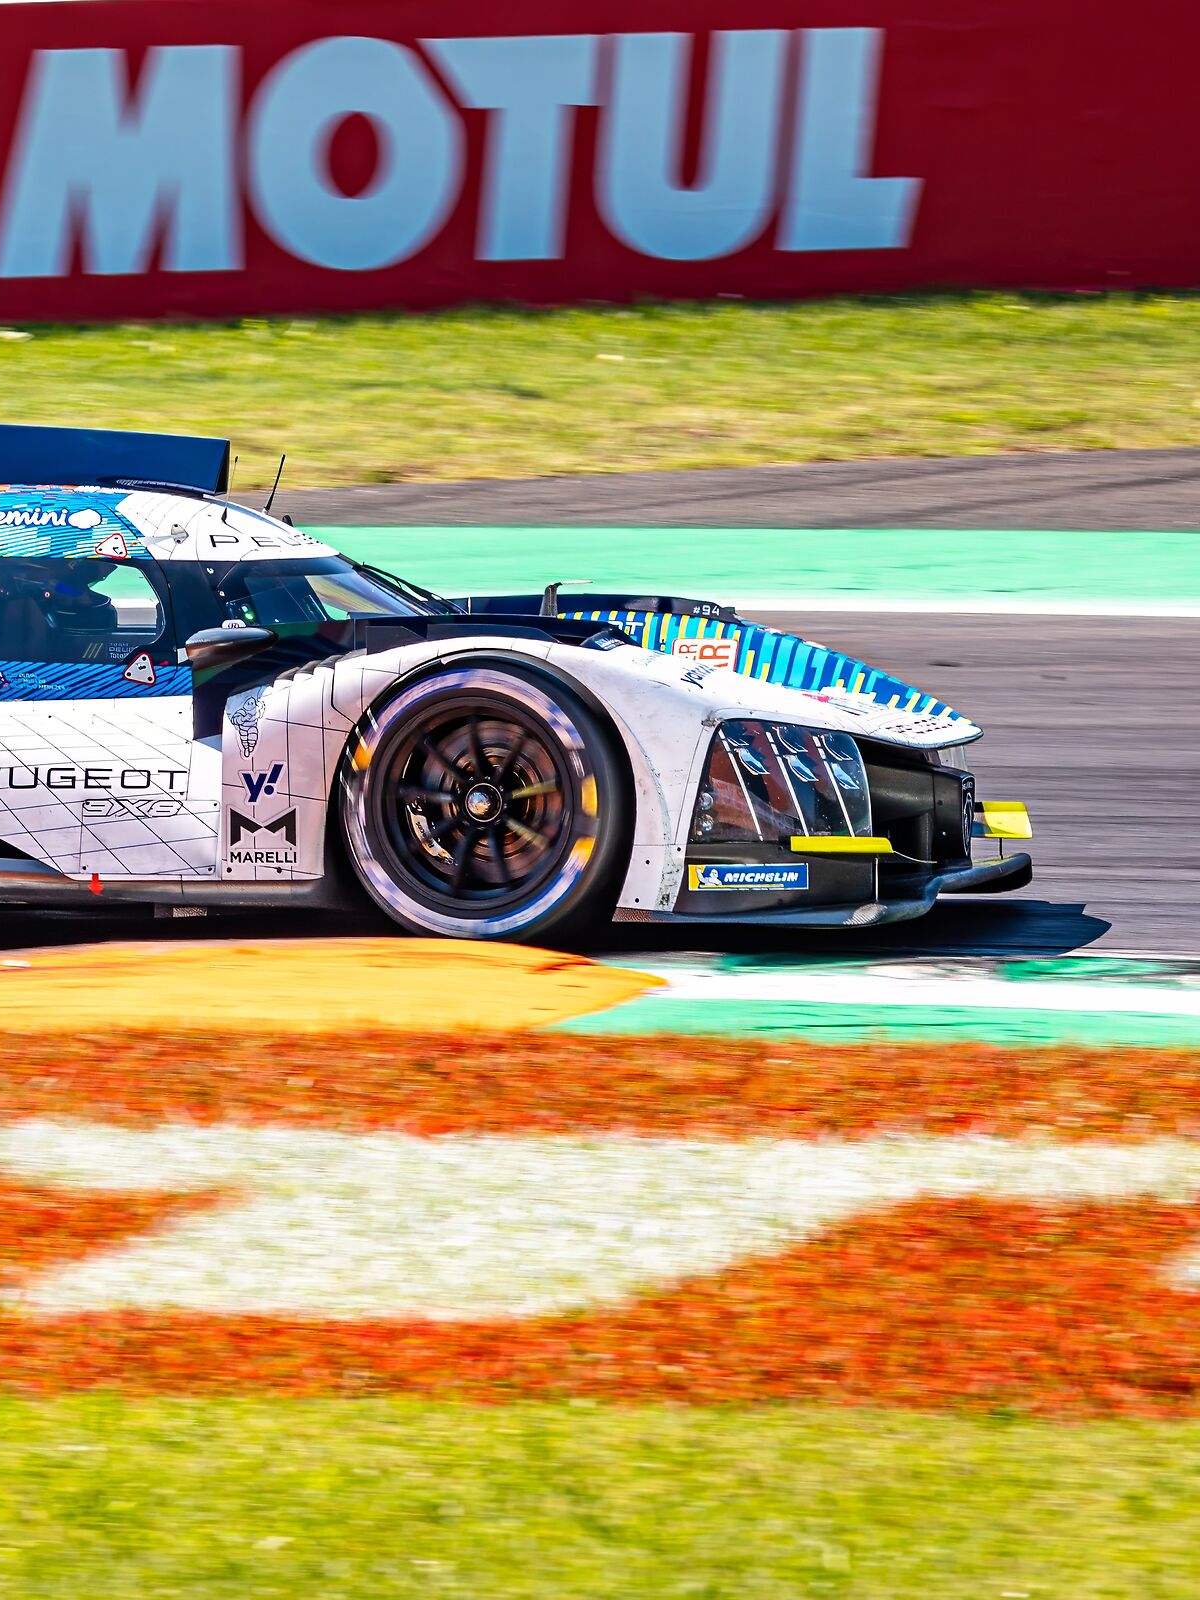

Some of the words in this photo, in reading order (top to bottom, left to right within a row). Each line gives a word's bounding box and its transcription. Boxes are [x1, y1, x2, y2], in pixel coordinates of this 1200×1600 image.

[693, 605, 720, 616] #94
[243, 762, 287, 802] y!
[229, 851, 298, 864] MARELLI
[724, 872, 799, 882] MICHELIN
